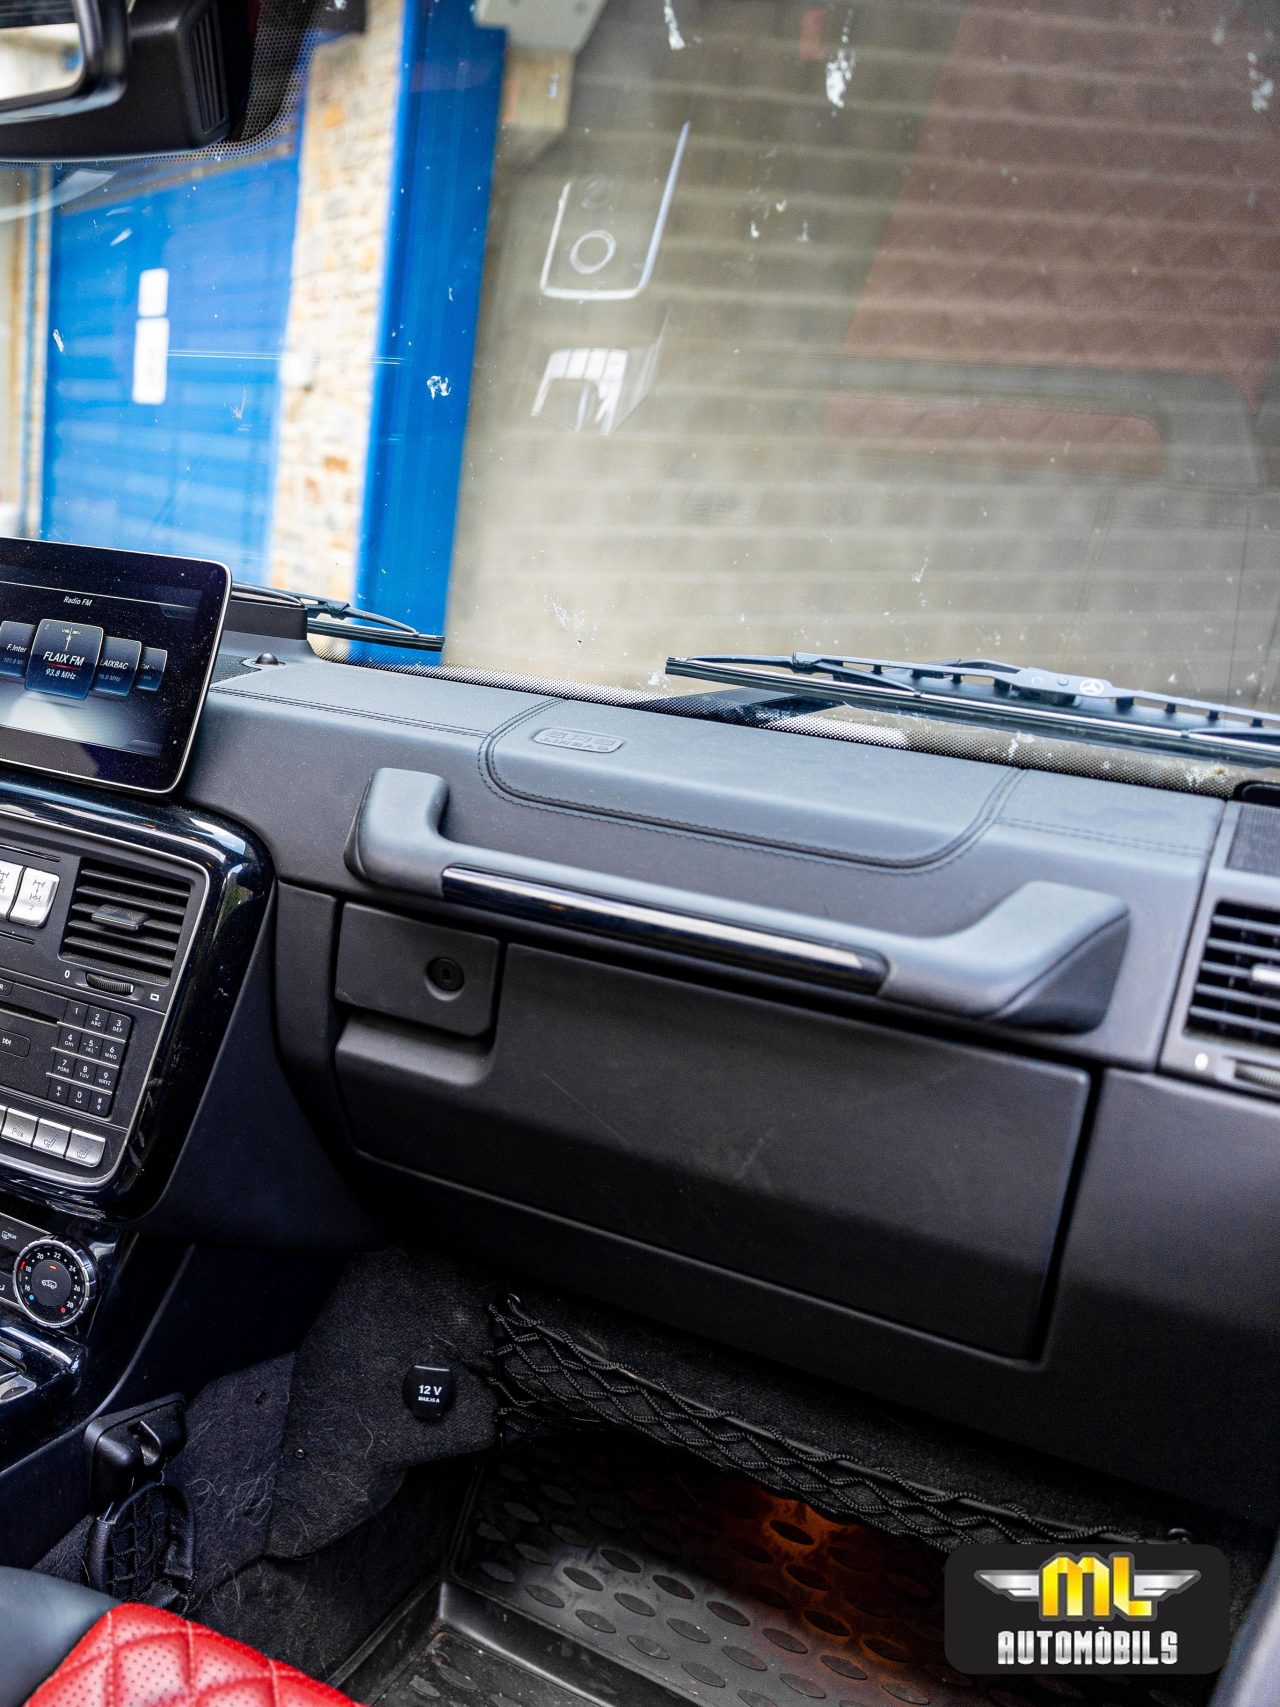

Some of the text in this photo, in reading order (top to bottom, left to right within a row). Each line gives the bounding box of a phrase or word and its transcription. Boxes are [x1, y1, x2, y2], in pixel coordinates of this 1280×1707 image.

[63, 596, 93, 606] Radio FM
[43, 651, 85, 666] FLAIX FM
[45, 668, 77, 680] 93.8 MHz
[94, 1013, 100, 1021] 2
[116, 1019, 122, 1027] 3
[82, 1065, 88, 1073] 8
[36, 1252, 44, 1260] 20
[25, 1265, 32, 1273] 18
[69, 1265, 76, 1273] 24
[73, 1284, 81, 1292] 26
[66, 1301, 74, 1309] 28
[419, 1384, 442, 1396] 12 V
